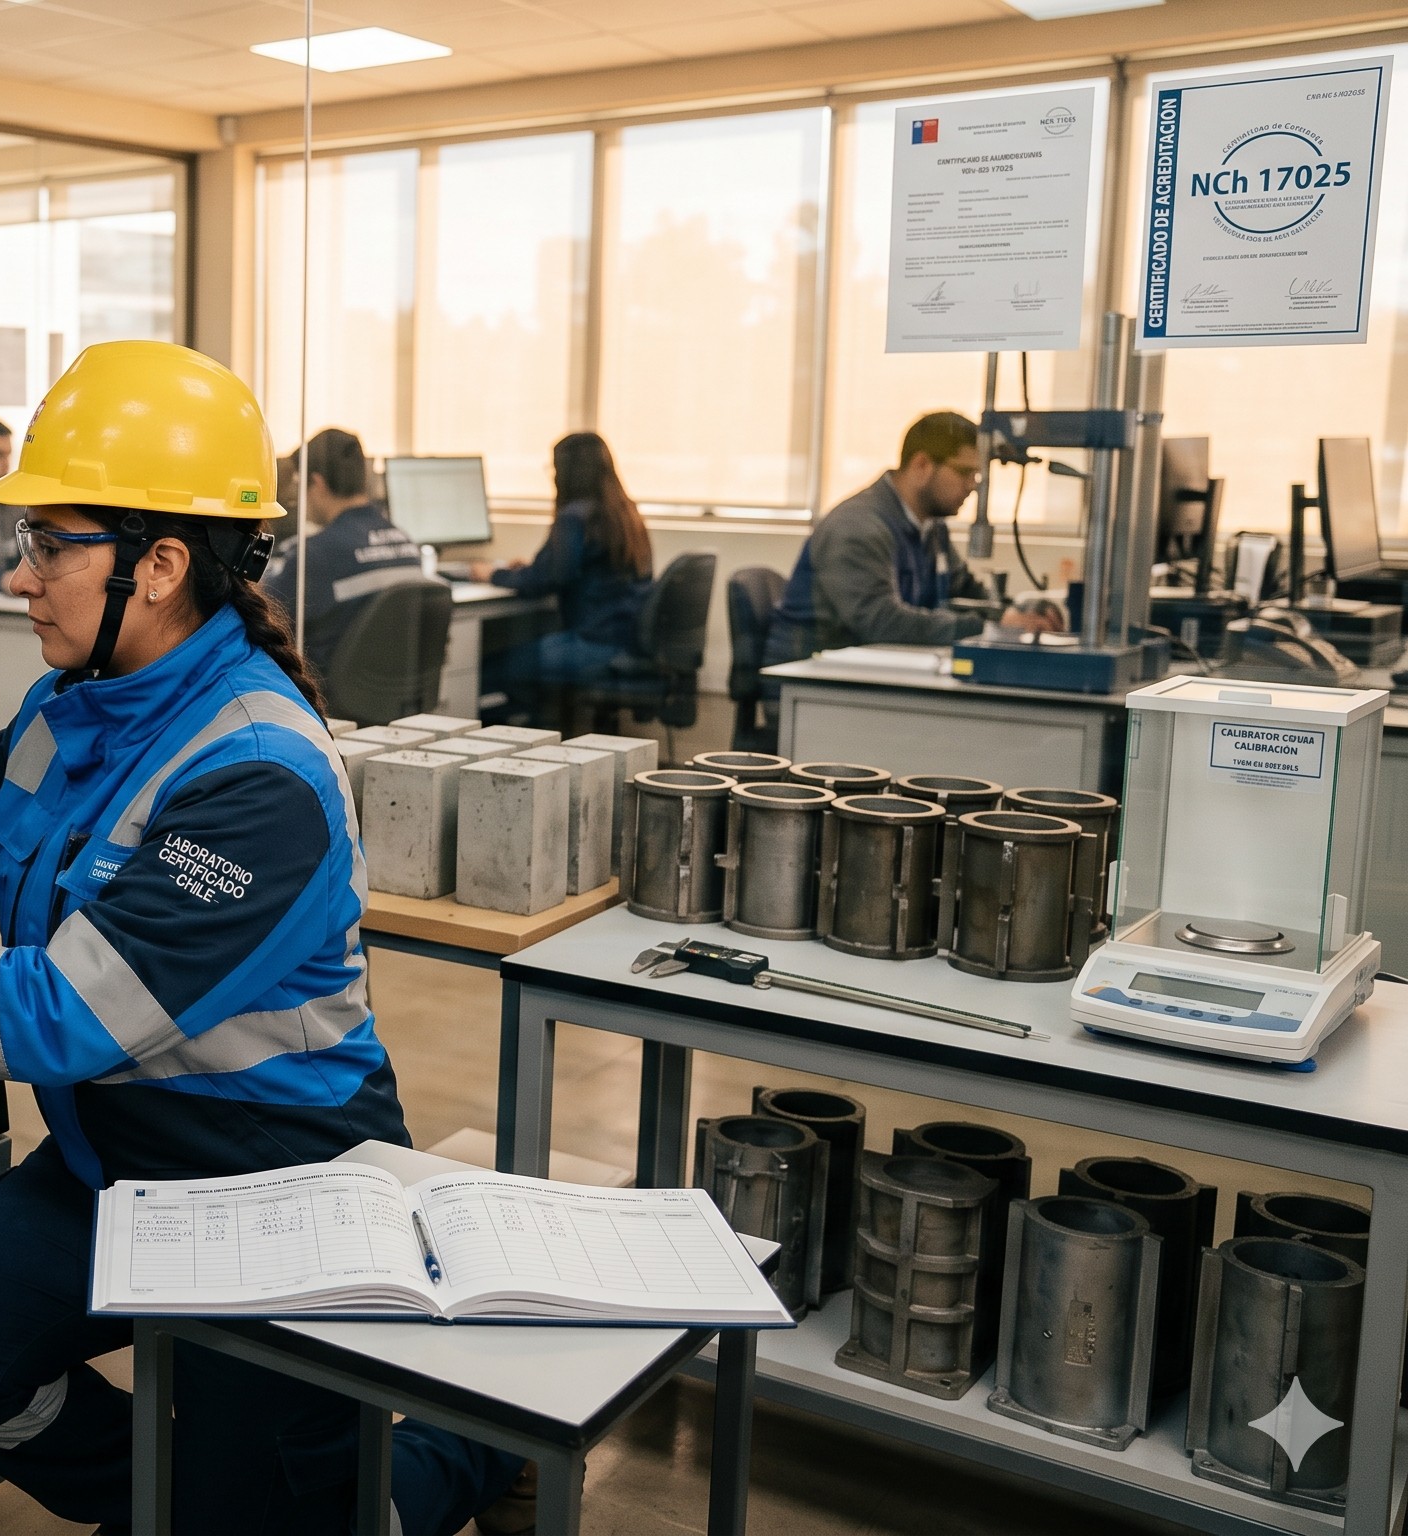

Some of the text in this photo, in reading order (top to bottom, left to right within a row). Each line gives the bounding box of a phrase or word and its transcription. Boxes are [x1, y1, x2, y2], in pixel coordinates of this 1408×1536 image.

[1191, 162, 1351, 196] NCh 17025
[1154, 208, 1169, 231] DE
[1221, 728, 1280, 741] CALIBRATOR
[1234, 741, 1298, 755] CALIBRACIÓN
[164, 833, 253, 885] LABORATORIO
[158, 848, 245, 899] CERTIFICADO
